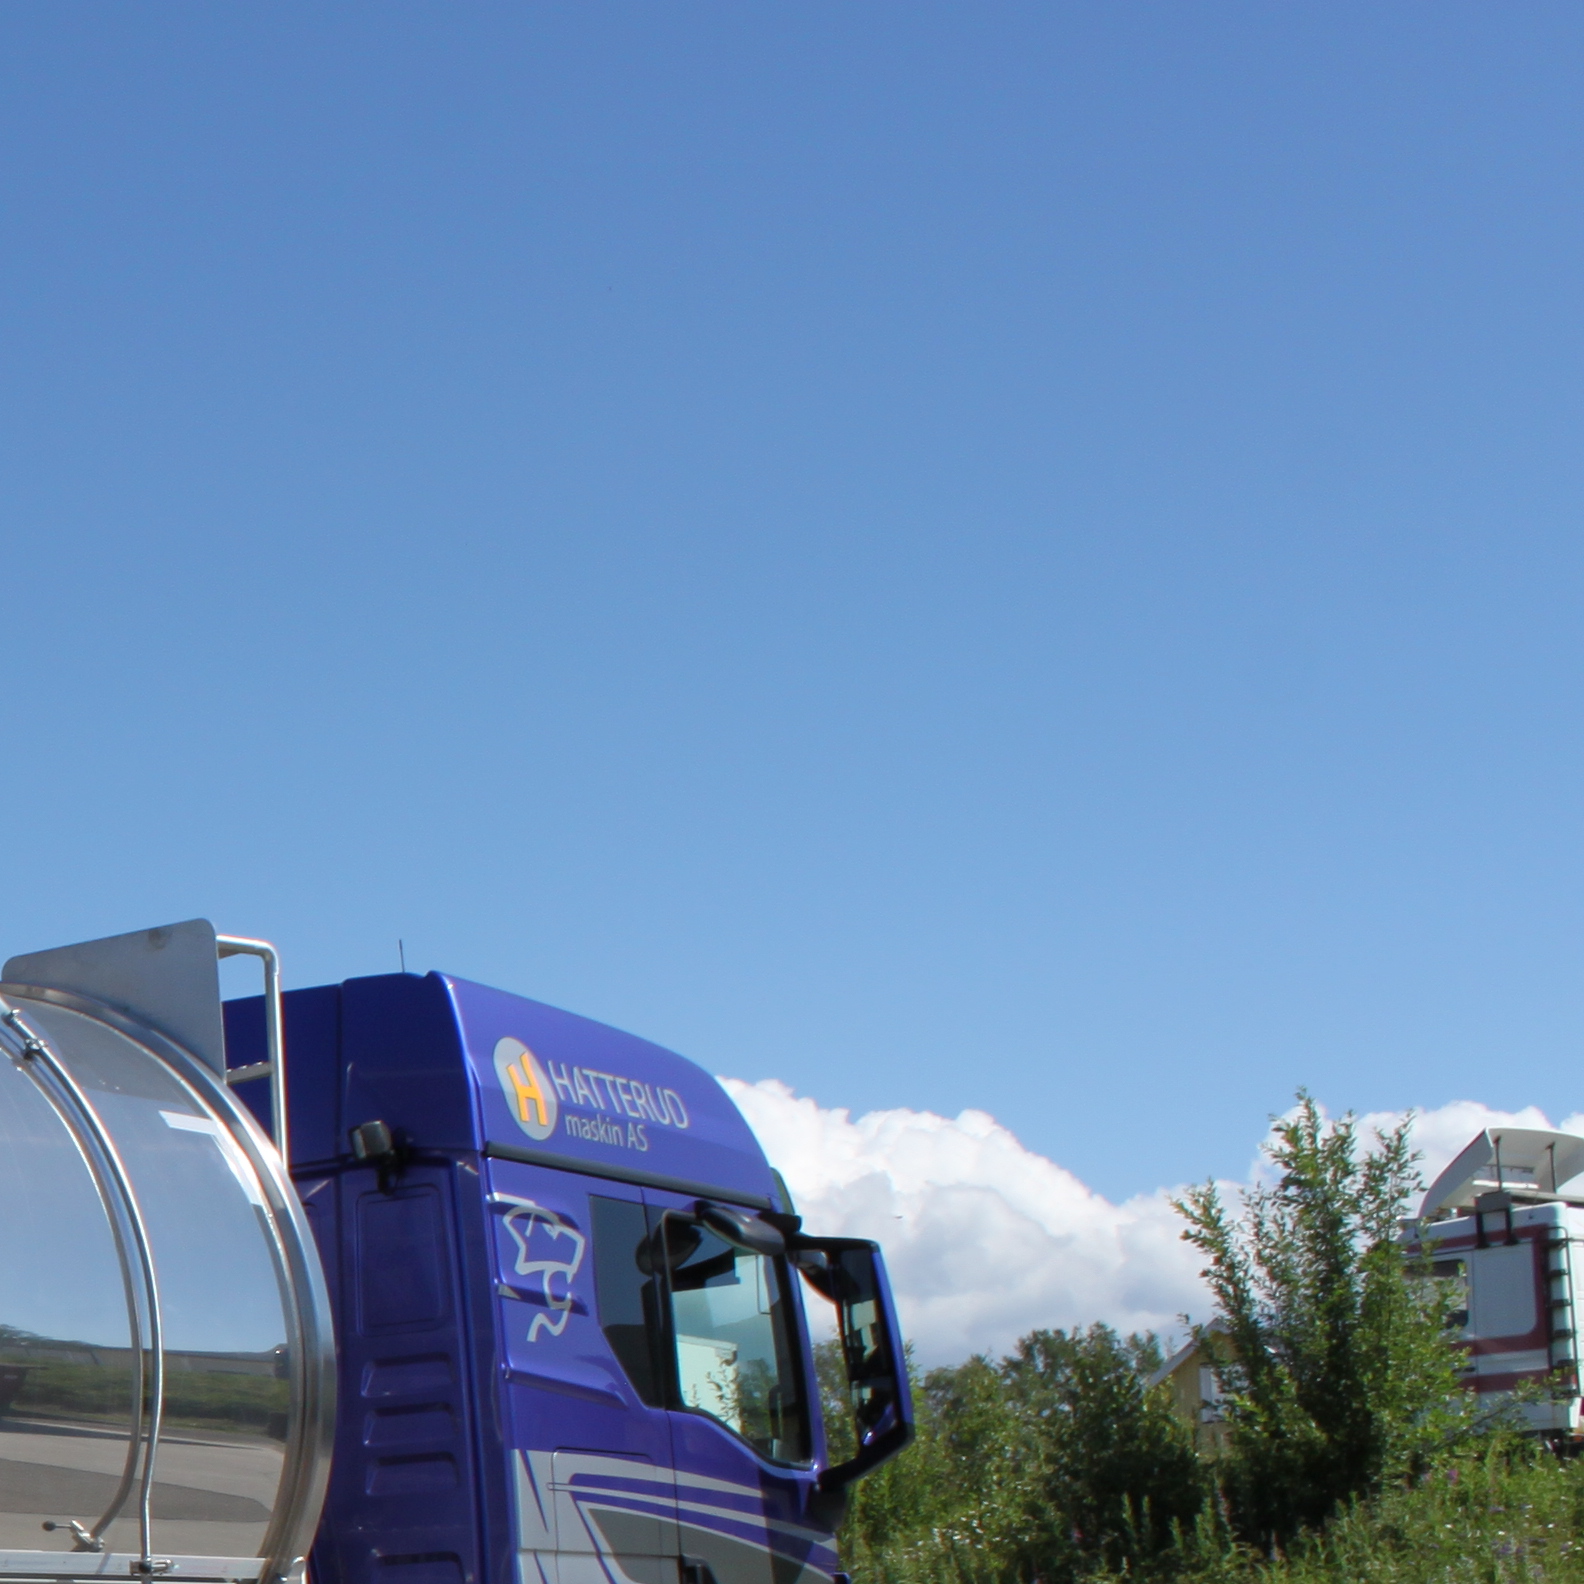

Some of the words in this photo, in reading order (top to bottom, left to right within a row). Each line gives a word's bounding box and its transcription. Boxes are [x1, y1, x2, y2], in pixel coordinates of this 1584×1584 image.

[549, 1061, 688, 1129] HATTERUD
[565, 1112, 624, 1148] maskin
[627, 1125, 650, 1152] AS
